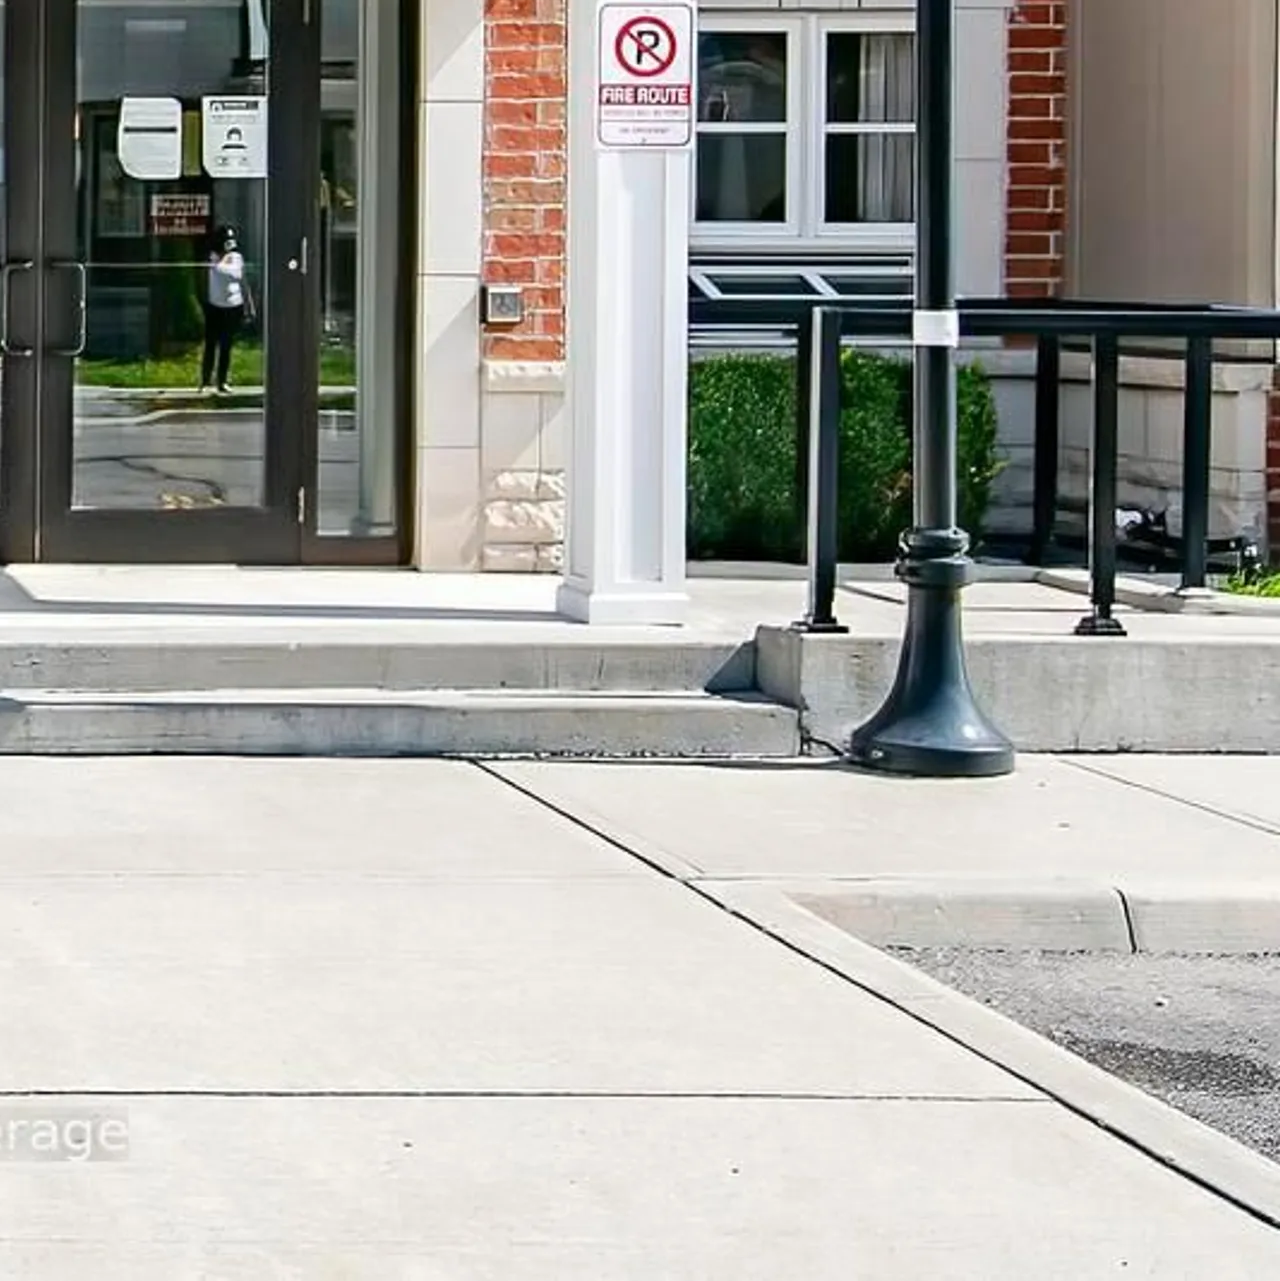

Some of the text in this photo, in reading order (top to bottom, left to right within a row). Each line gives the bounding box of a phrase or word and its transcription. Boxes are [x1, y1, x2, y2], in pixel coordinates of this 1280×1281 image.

[636, 30, 660, 65] P
[601, 87, 688, 104] FIRE ROUTE
